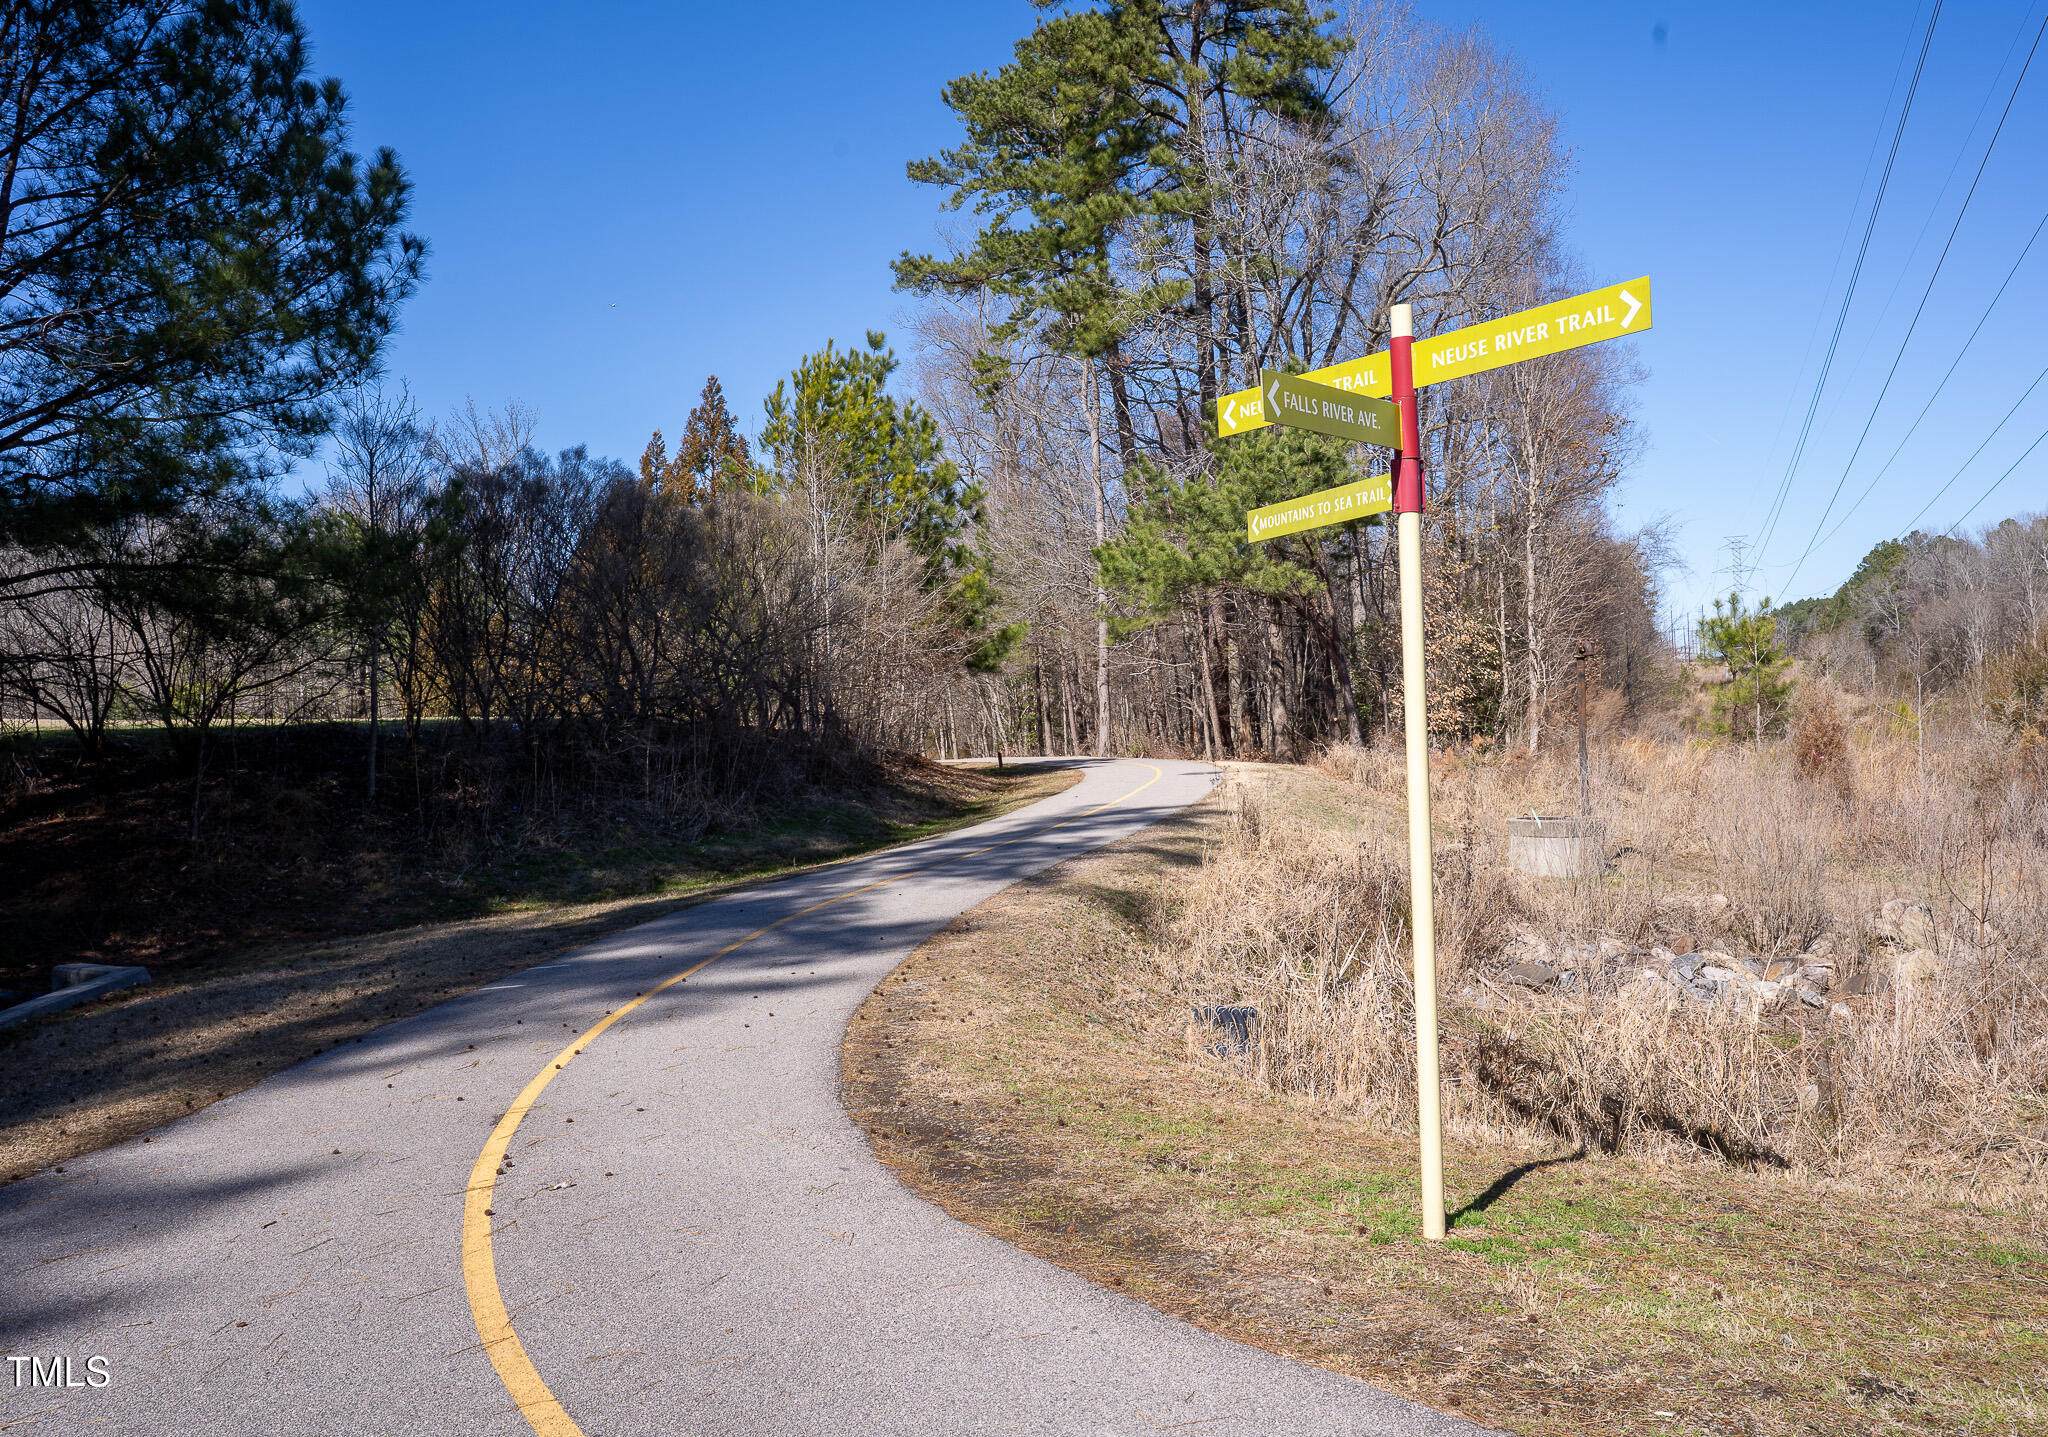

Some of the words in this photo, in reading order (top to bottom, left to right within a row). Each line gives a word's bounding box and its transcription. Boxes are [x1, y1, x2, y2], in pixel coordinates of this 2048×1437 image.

[1431, 338, 1489, 369] NEUSE
[1494, 322, 1549, 352] RIVER
[1555, 305, 1615, 335] TRAIL
[1239, 399, 1264, 419] NEU
[1332, 369, 1379, 392] TRAIL
[1283, 391, 1318, 415] FALLS
[1322, 401, 1355, 424] RIVER
[1357, 410, 1381, 430] AVE.
[1259, 504, 1315, 531] MOUNTAINS
[1317, 501, 1331, 516] TO
[1334, 495, 1353, 512] SEA
[1355, 487, 1386, 506] TRAIL
